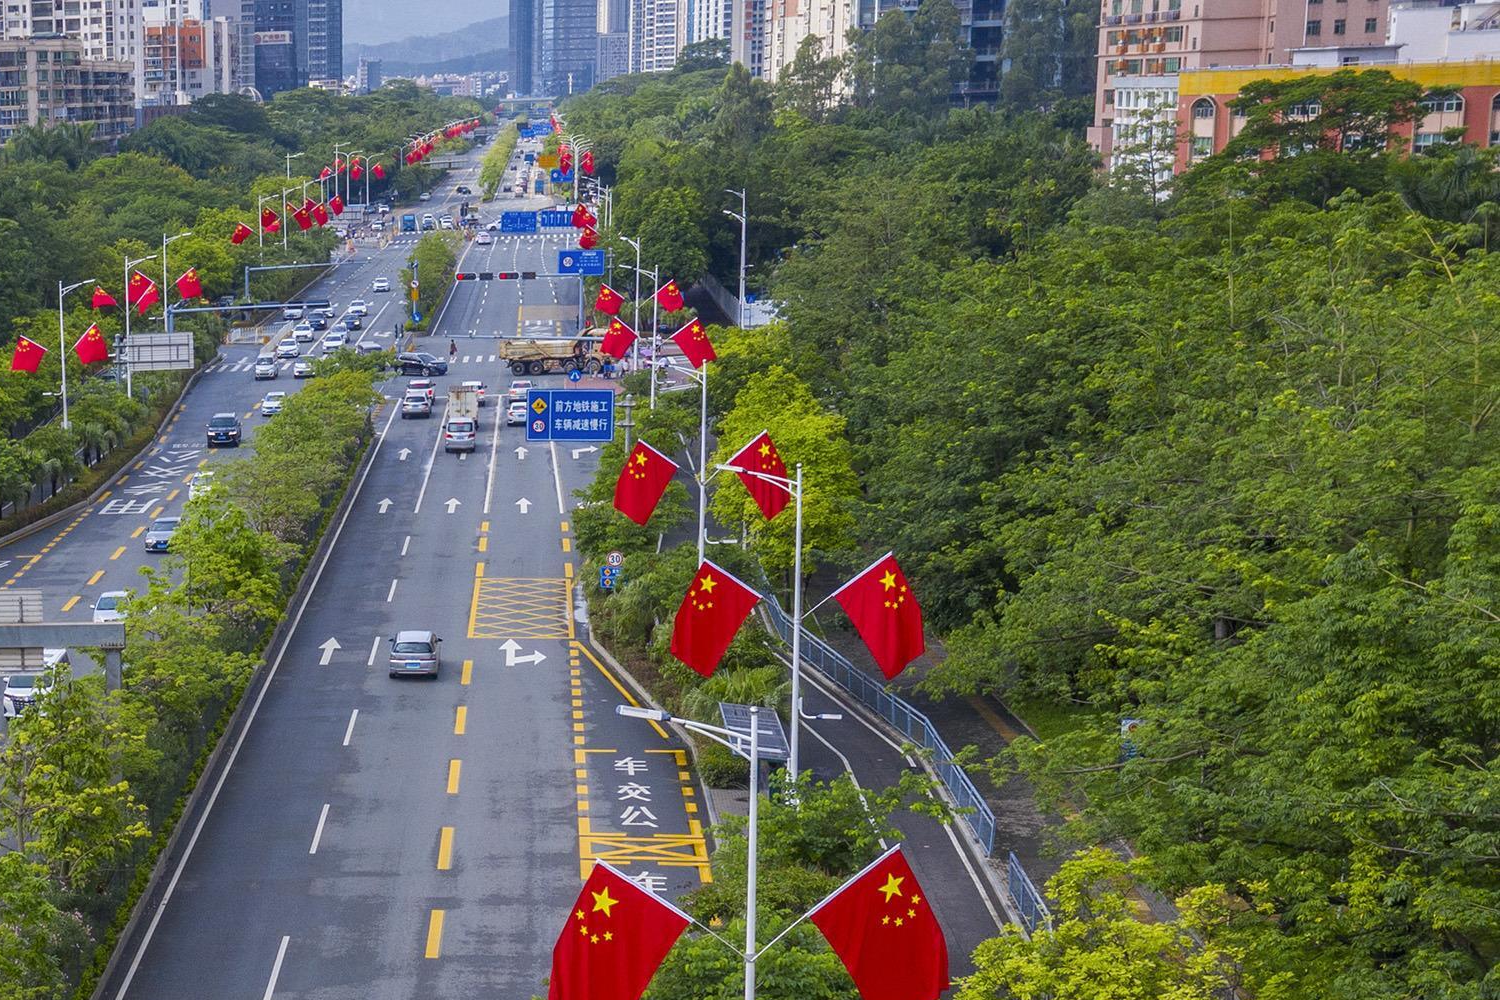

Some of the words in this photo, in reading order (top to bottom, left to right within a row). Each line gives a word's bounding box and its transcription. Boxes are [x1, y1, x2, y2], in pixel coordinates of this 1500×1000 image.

[555, 400, 608, 413] 前方地铁施工
[534, 422, 543, 430] 30
[555, 419, 608, 431] 车辆减速慢行
[610, 555, 621, 564] 30
